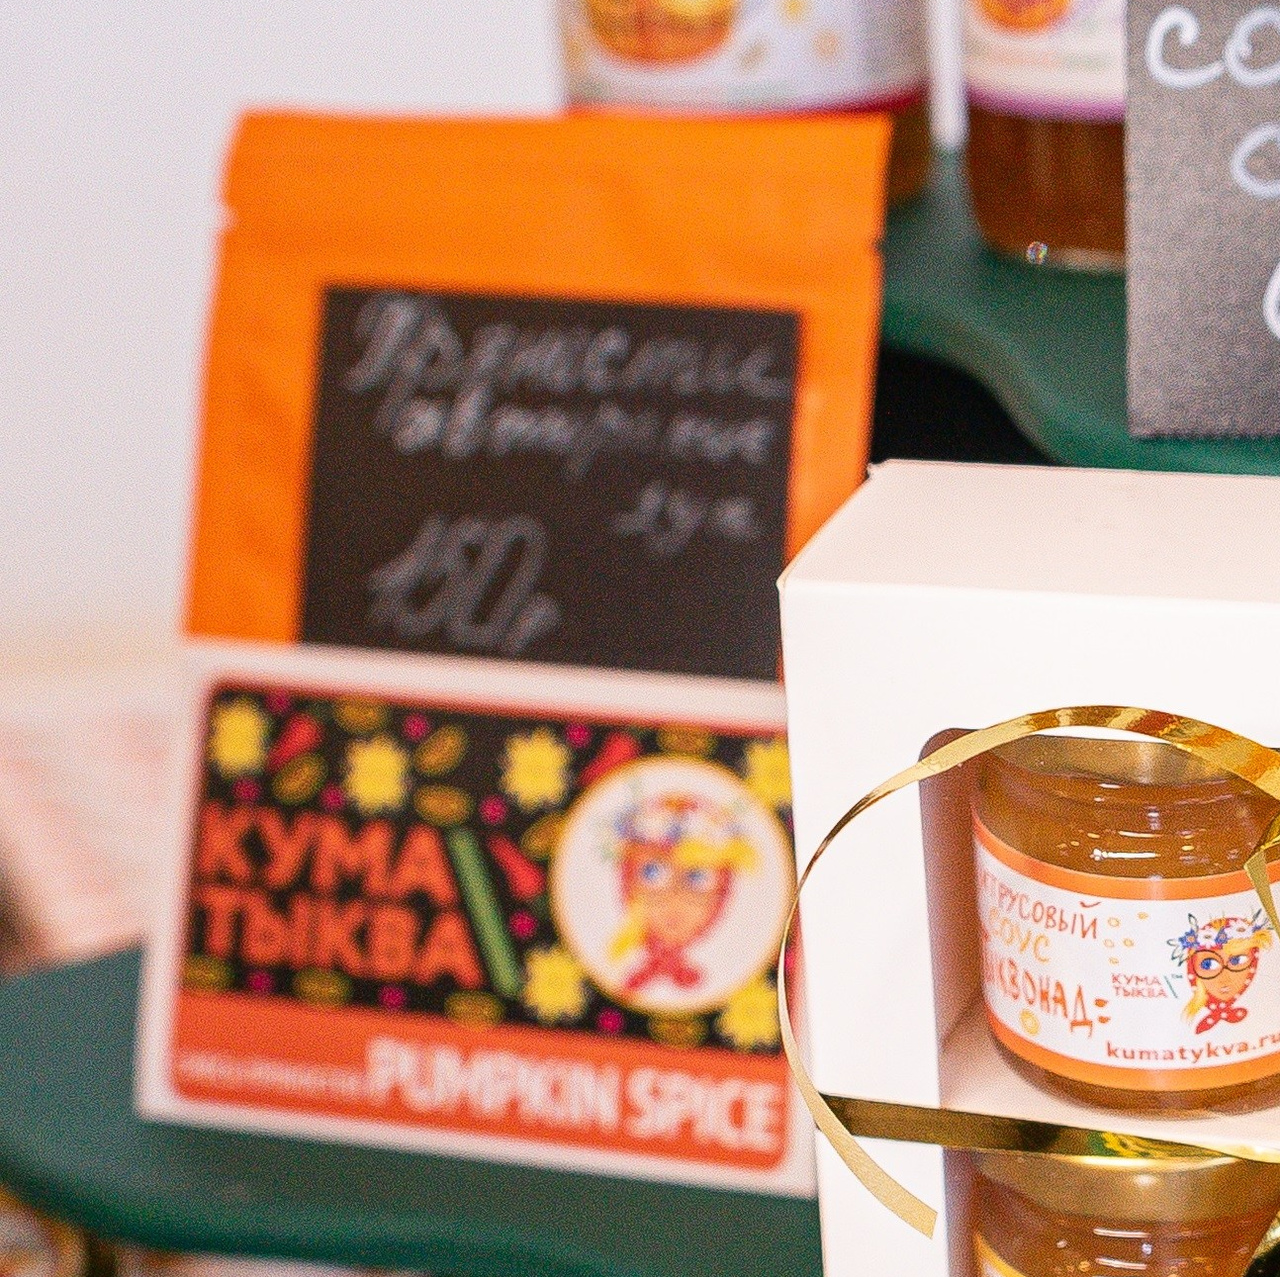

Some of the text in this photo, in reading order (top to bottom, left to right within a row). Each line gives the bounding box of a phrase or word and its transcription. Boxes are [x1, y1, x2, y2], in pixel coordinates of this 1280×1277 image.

[202, 802, 456, 905] КУМА
[197, 885, 484, 990] ТЫКВА
[1111, 973, 1162, 987] КУМА
[1114, 986, 1168, 999] ТЫКВА
[366, 1037, 620, 1134] PUMPKIN
[625, 1070, 784, 1152] SPICE
